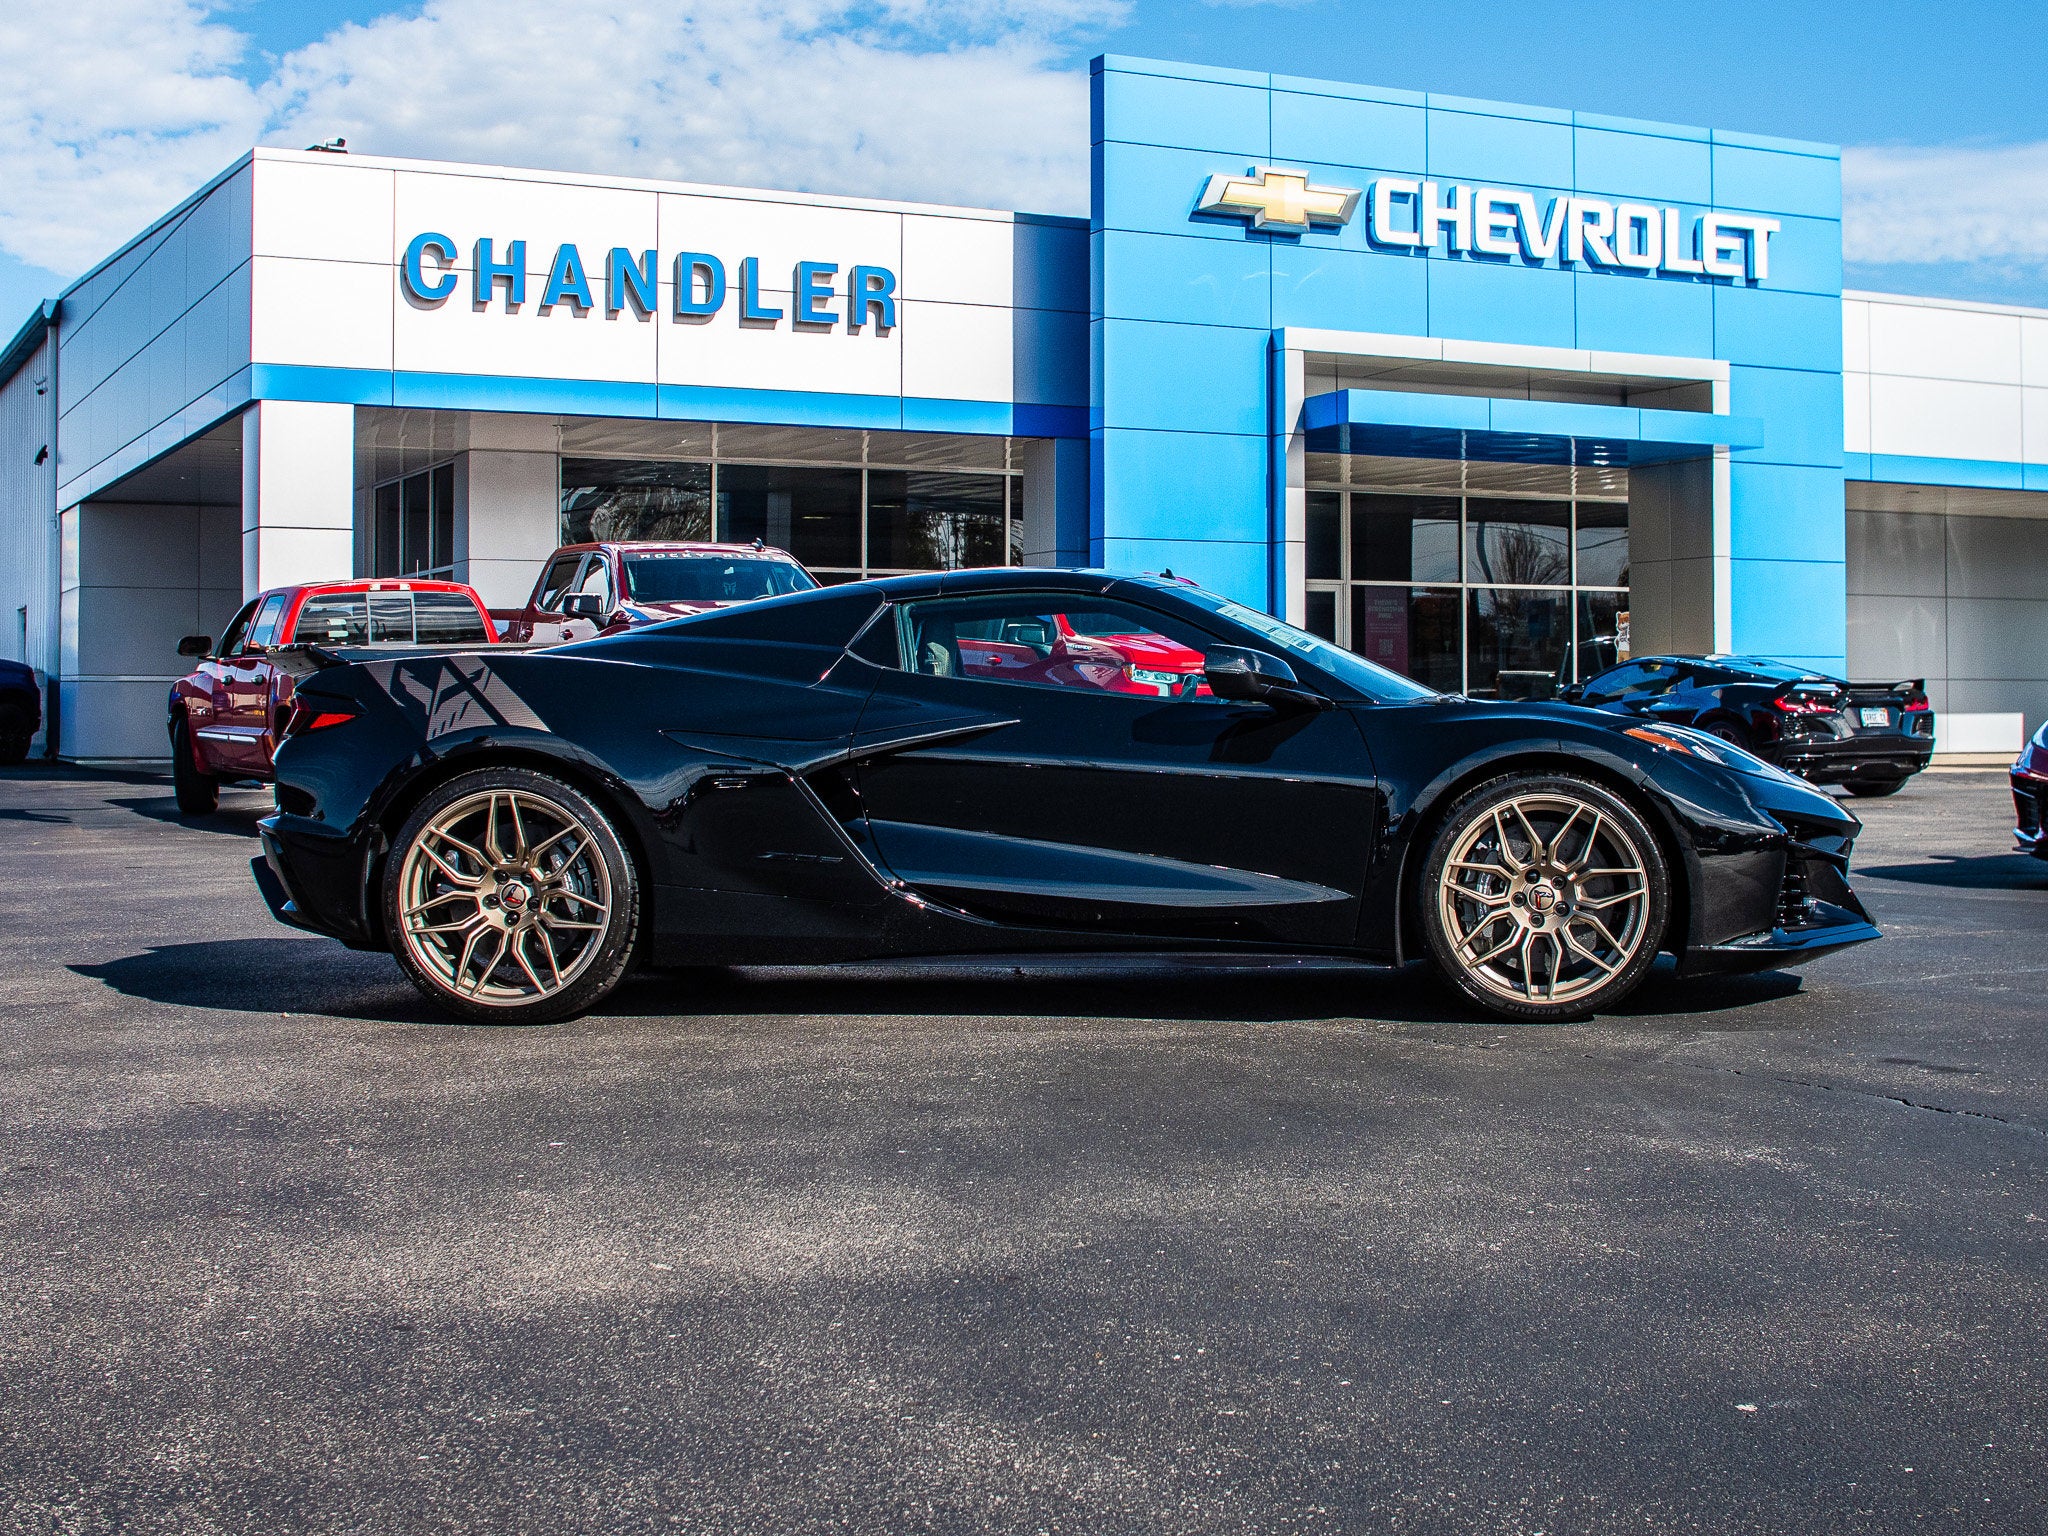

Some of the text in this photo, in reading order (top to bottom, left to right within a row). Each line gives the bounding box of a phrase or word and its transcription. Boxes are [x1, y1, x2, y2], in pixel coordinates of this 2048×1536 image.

[1371, 177, 1781, 282] CHEVROLET
[401, 232, 897, 333] CHANDLER
[639, 551, 706, 559] ROCKY
[1506, 1003, 1561, 1015] MICHELIN
